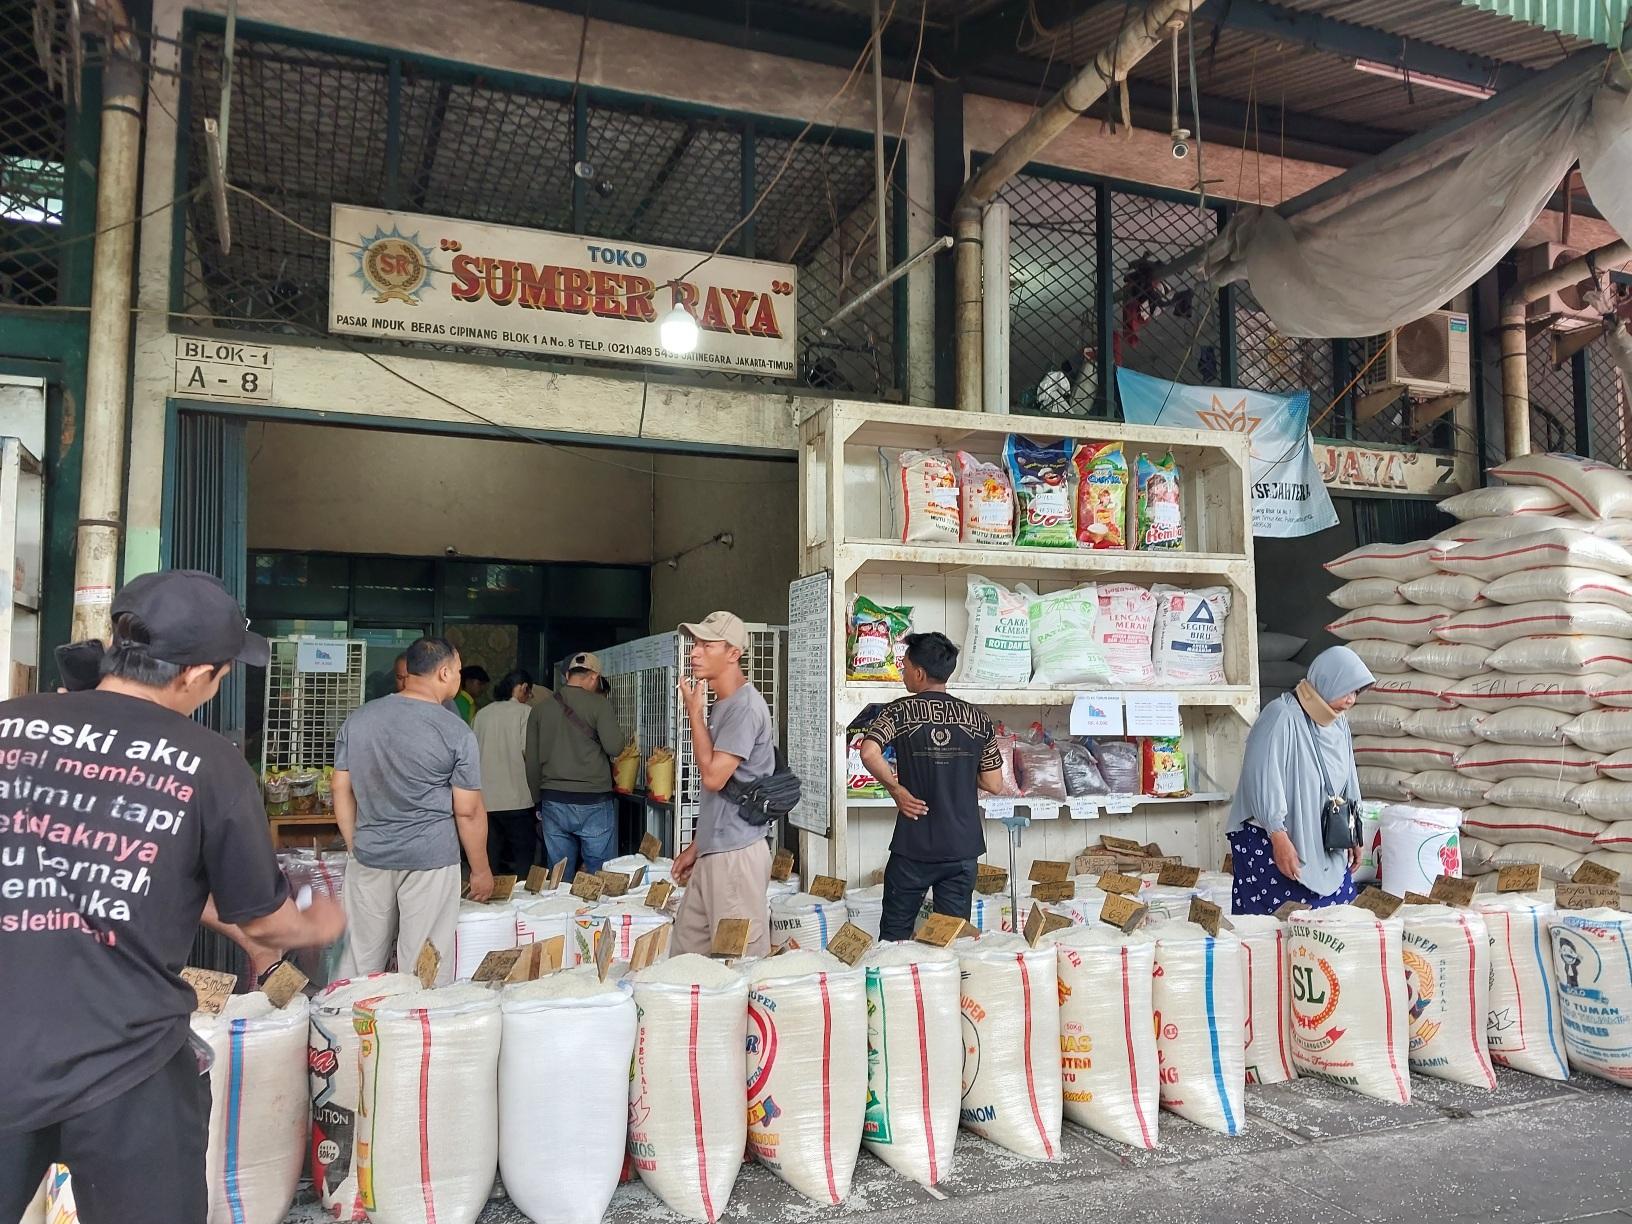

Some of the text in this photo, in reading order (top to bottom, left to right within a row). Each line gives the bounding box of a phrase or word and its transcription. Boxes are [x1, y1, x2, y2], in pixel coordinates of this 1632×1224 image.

[380, 254, 410, 277] SR
[587, 245, 648, 269] TOKO
[336, 315, 368, 328] PASAR
[371, 318, 405, 331] INDUK
[411, 321, 446, 335] BERAS
[449, 326, 498, 340] CIPINANG
[502, 331, 530, 344] BLOK
[578, 339, 605, 352] TELP.
[735, 356, 794, 371] JAKARTA-TIMUR
[1109, 614, 1151, 623] LENCANA
[1115, 621, 1147, 631] MERAH
[1181, 623, 1218, 633] SEGITIGA
[1190, 631, 1211, 640] BIRU
[988, 639, 1007, 649] ROTI
[0, 717, 201, 776] meski aku
[55, 757, 195, 803] membuka
[110, 793, 186, 836] tapi
[773, 919, 803, 931] SUPER
[1312, 929, 1346, 954] SUPER
[1292, 964, 1326, 1005] SL
[1574, 1003, 1619, 1016] TUMAN
[319, 1150, 337, 1161] 50kg
